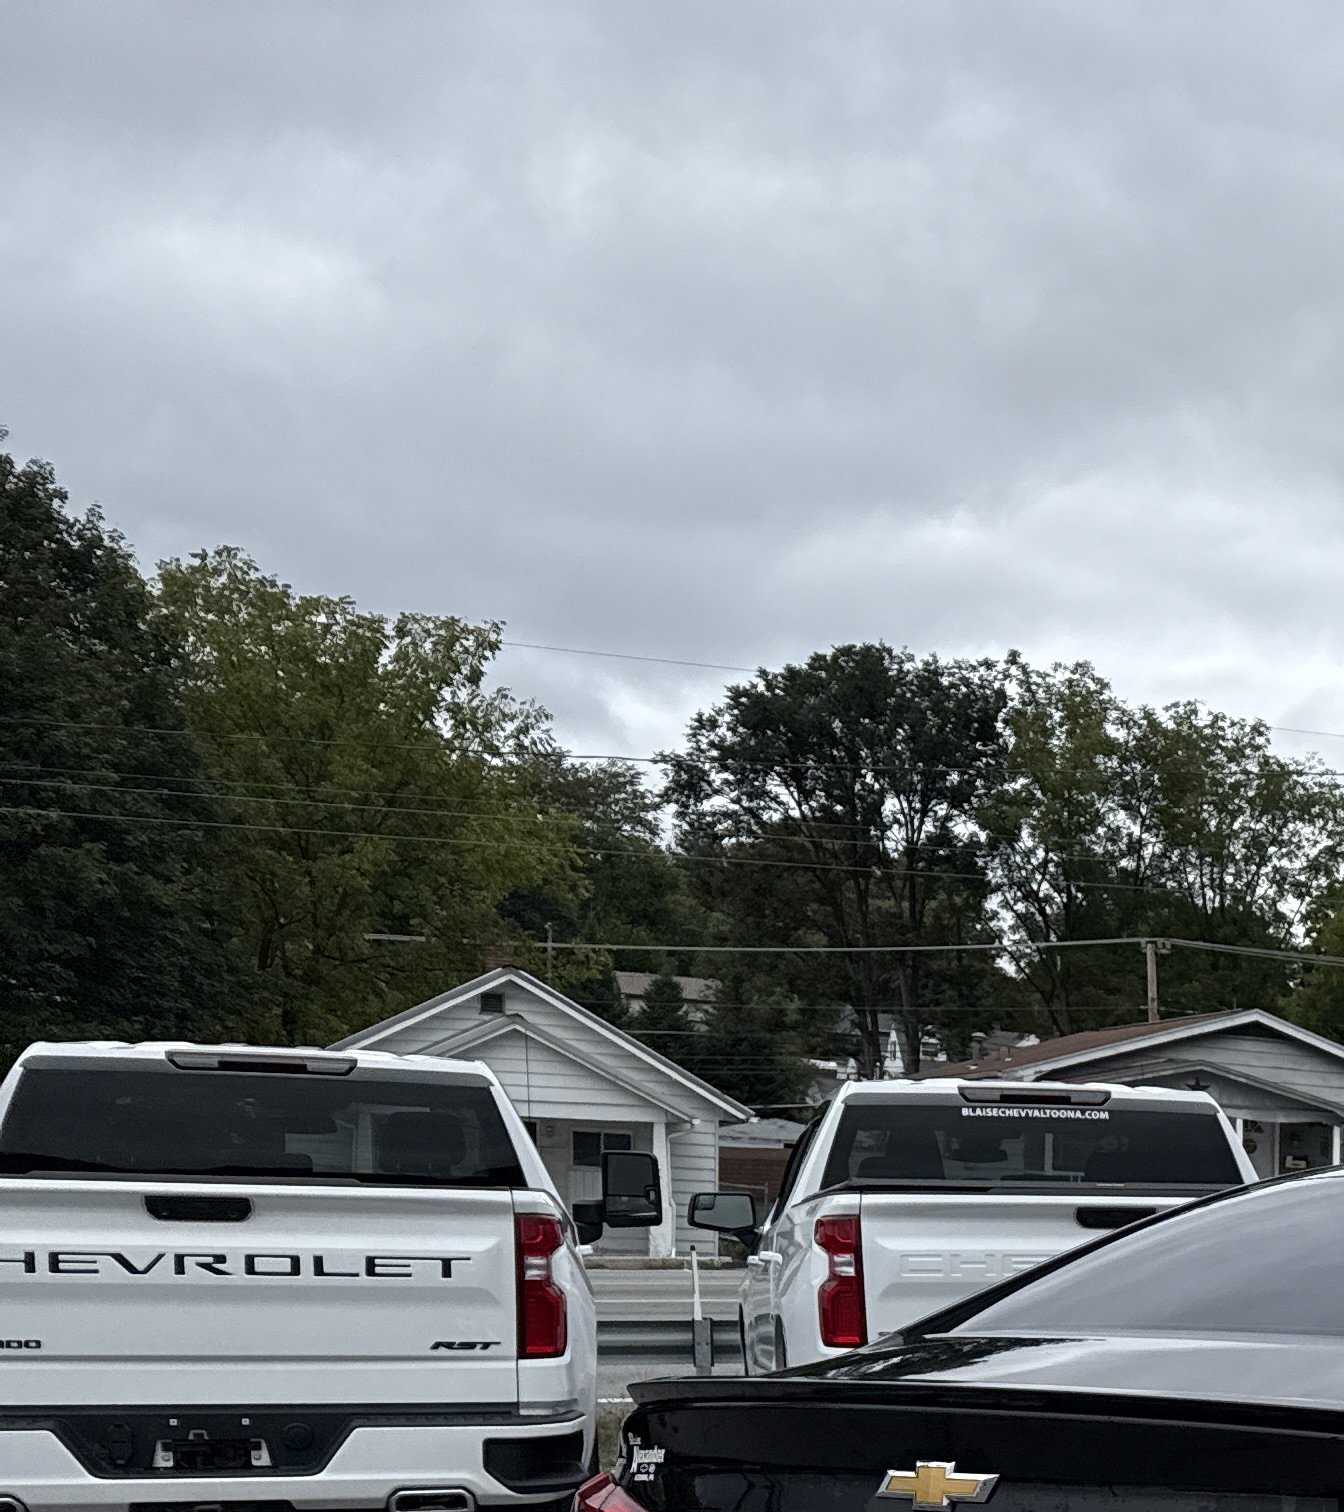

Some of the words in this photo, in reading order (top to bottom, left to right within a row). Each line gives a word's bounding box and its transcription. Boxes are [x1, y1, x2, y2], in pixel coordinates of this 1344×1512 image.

[961, 1107, 1110, 1120] BLAISECHEVYALTOONA.COM
[0, 1251, 471, 1278] HEVROLET
[430, 1341, 502, 1351] RST
